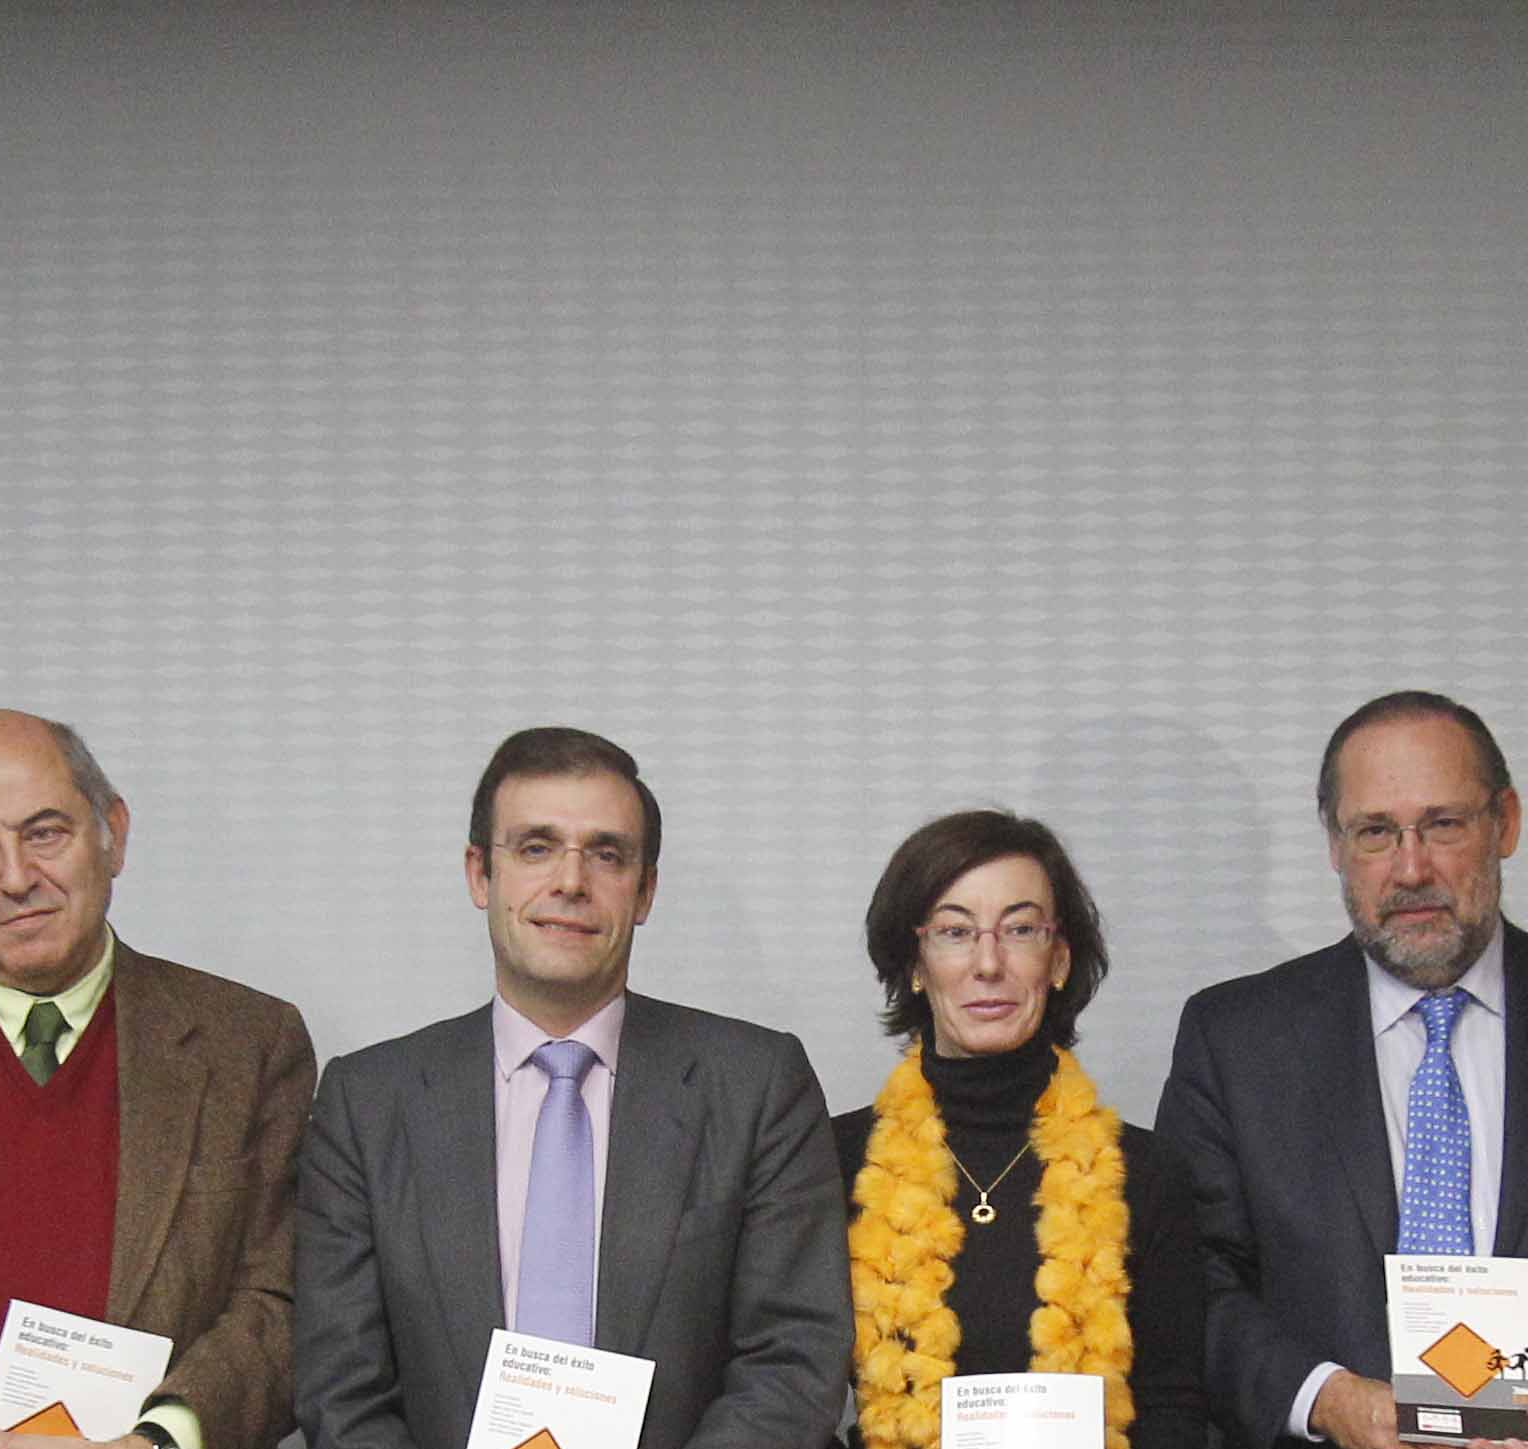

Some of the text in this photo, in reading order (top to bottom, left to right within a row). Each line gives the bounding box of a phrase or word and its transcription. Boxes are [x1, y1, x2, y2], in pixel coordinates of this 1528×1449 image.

[504, 1343, 596, 1371] En busca del éxito
[957, 1386, 970, 1398] En
[973, 1384, 1002, 1397] busca
